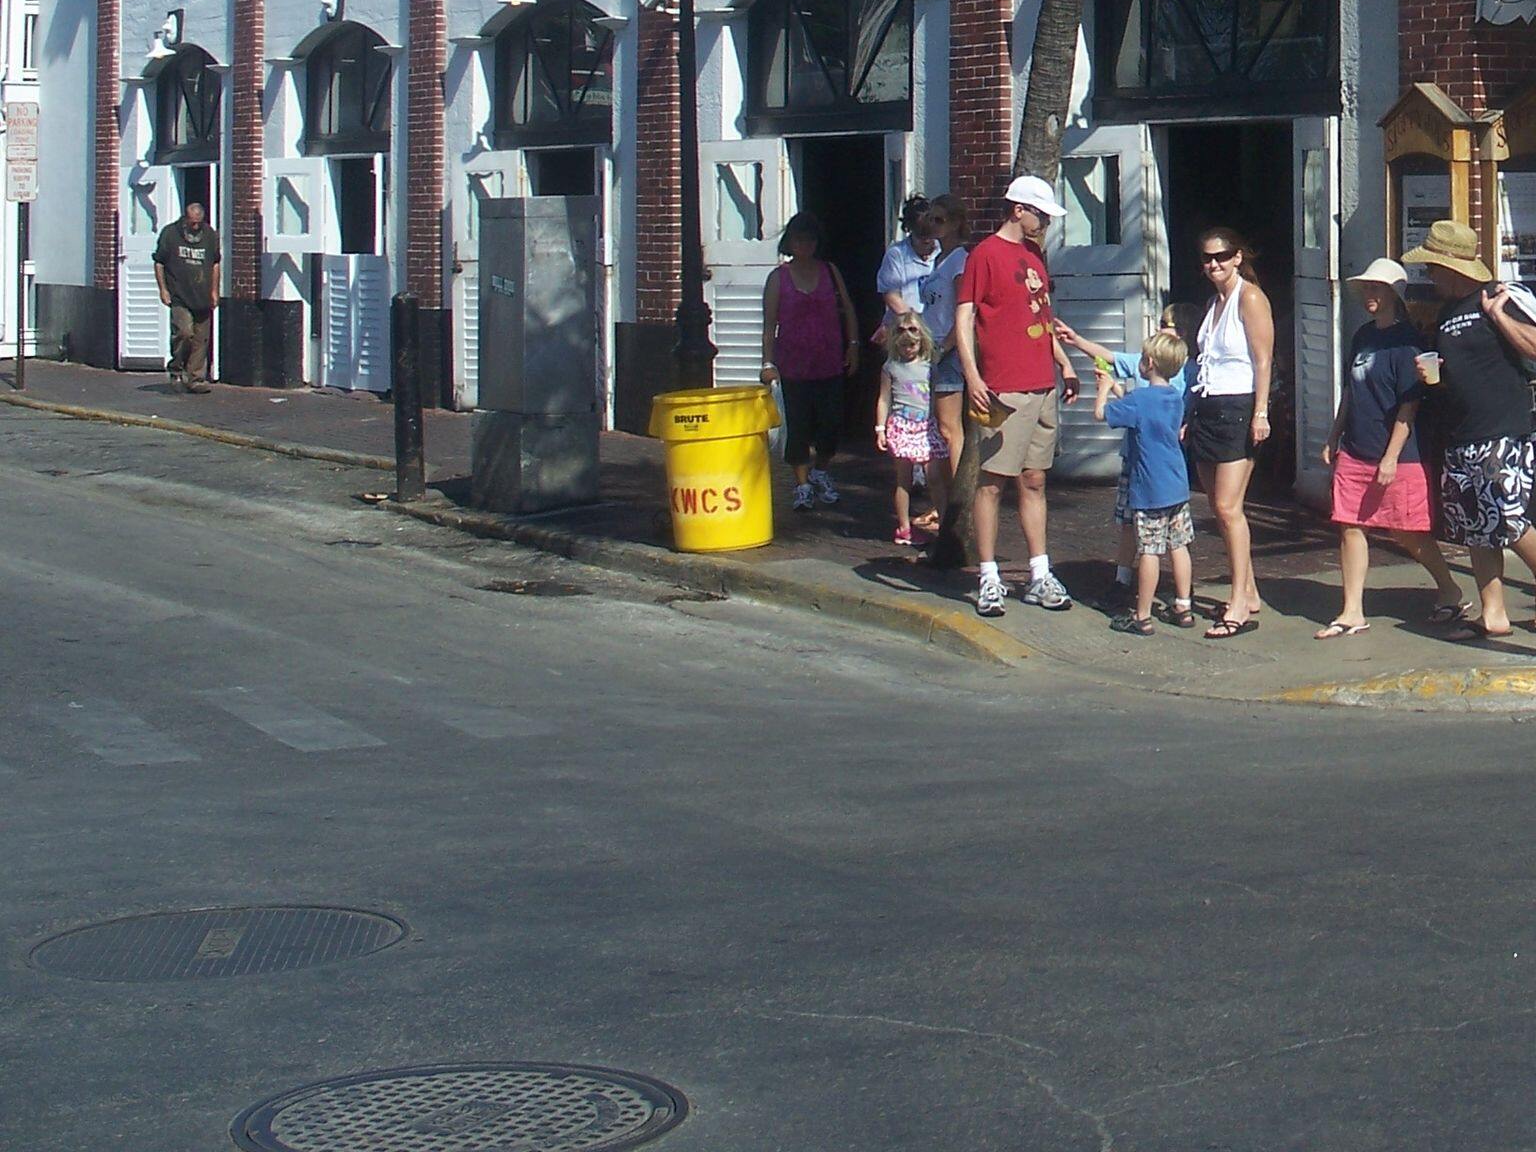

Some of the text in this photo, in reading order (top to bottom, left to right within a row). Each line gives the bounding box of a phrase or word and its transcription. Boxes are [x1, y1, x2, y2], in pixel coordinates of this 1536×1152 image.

[16, 106, 28, 116] NO
[8, 118, 37, 127] PARKING
[674, 414, 709, 423] BRUTE
[671, 486, 742, 515] KWCS
